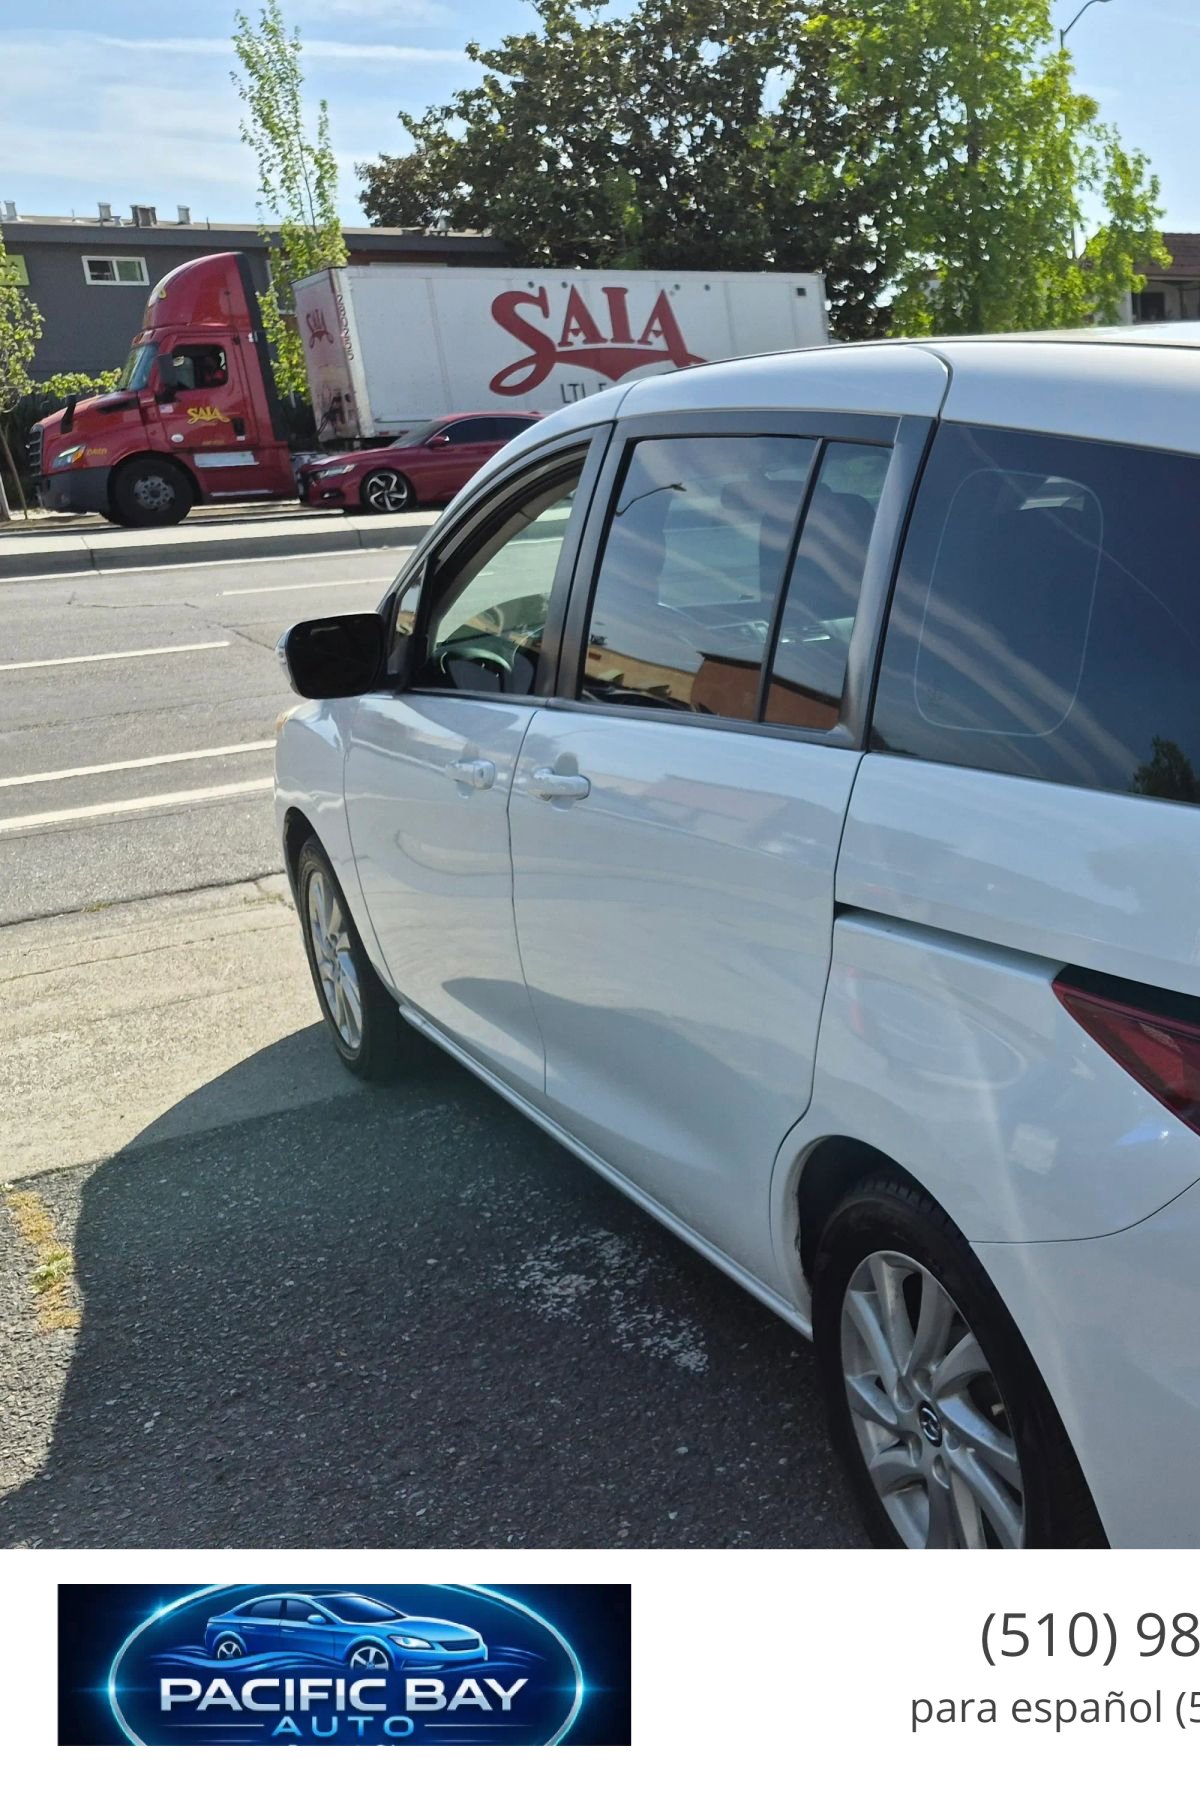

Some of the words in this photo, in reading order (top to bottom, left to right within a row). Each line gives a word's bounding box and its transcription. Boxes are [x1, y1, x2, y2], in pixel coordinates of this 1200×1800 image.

[305, 308, 334, 348] SAIA
[489, 284, 708, 397] SAIA
[187, 406, 230, 425] SAIA
